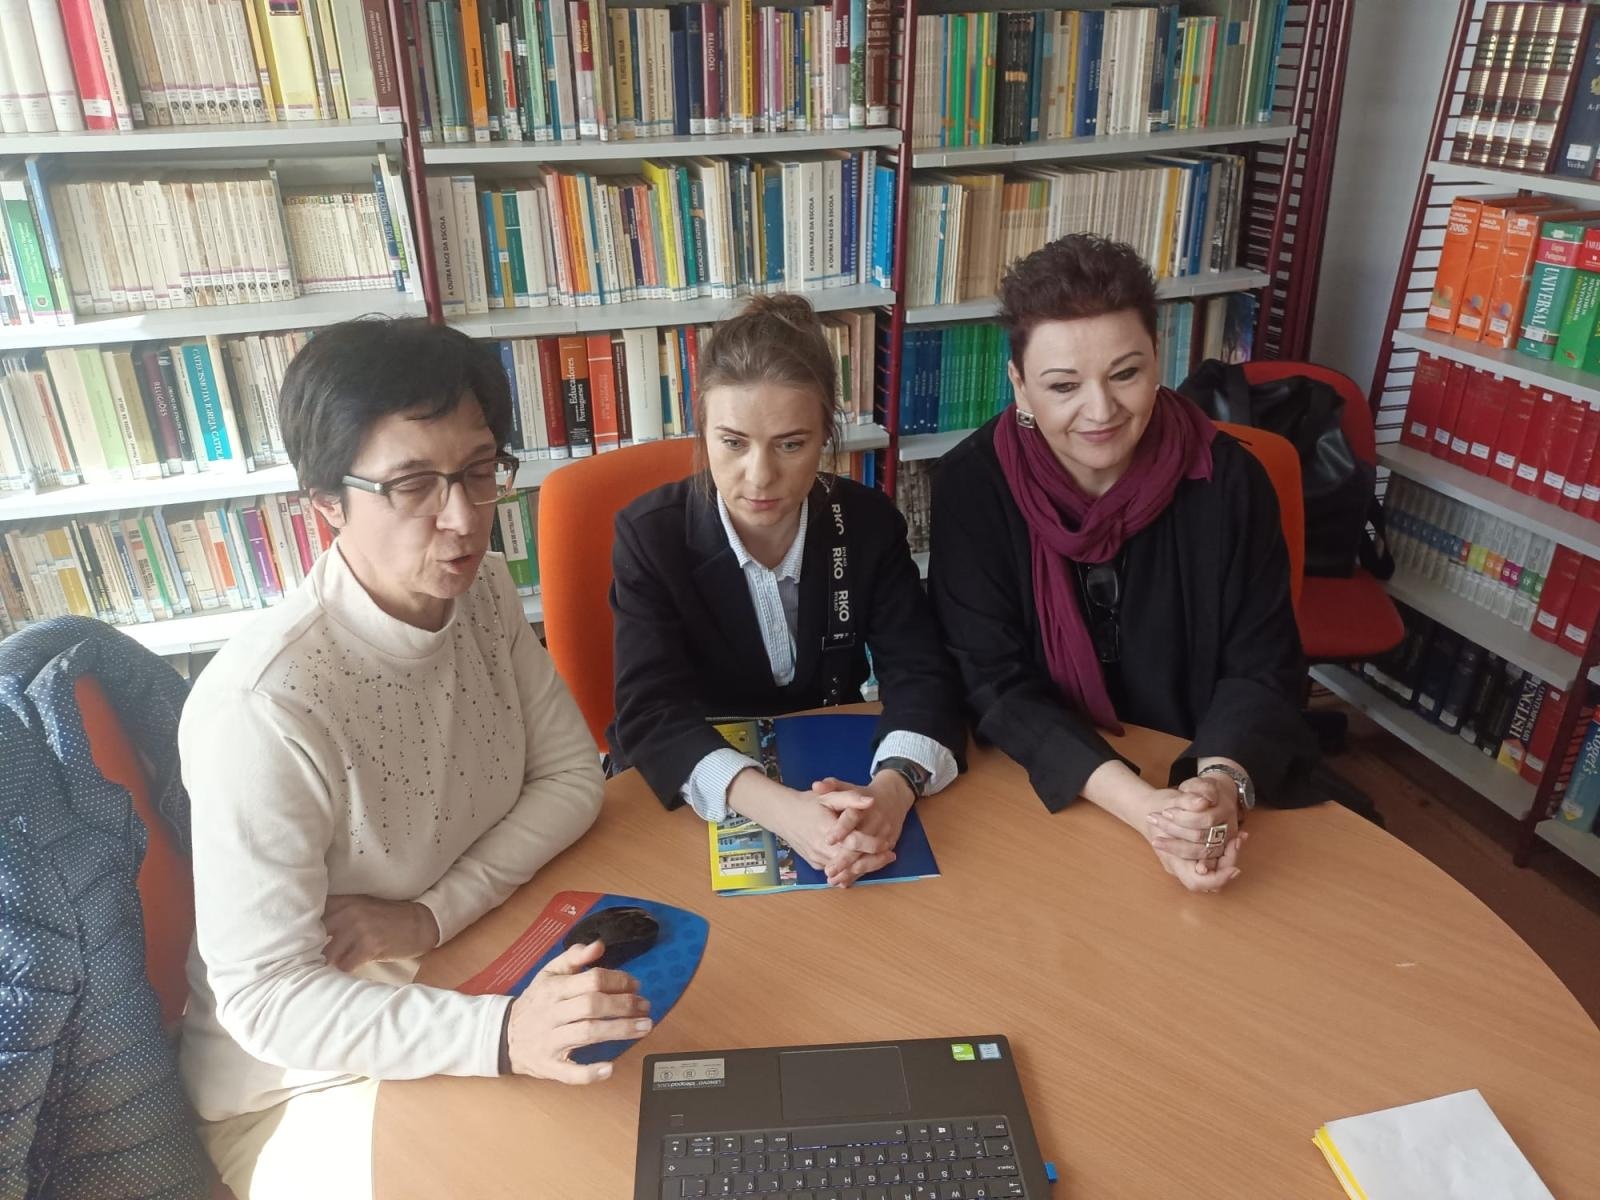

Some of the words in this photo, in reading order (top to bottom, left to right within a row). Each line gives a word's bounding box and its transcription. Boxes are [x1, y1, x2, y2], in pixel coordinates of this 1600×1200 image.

[582, 19, 590, 53] Alimentar
[440, 216, 448, 240] ESCOLA
[808, 221, 814, 230] DA
[828, 218, 834, 228] DA
[443, 242, 449, 252] DA
[446, 268, 454, 290] OUTRA
[1531, 267, 1560, 325] UNIVERSAL
[192, 348, 208, 390] CATECISMO
[205, 403, 217, 429] IGREJA
[566, 357, 578, 404] Educadores
[578, 384, 586, 422] Portugueses
[832, 547, 844, 580] RKO
[838, 590, 850, 622] RKO
[1508, 680, 1539, 738] ENGLISH
